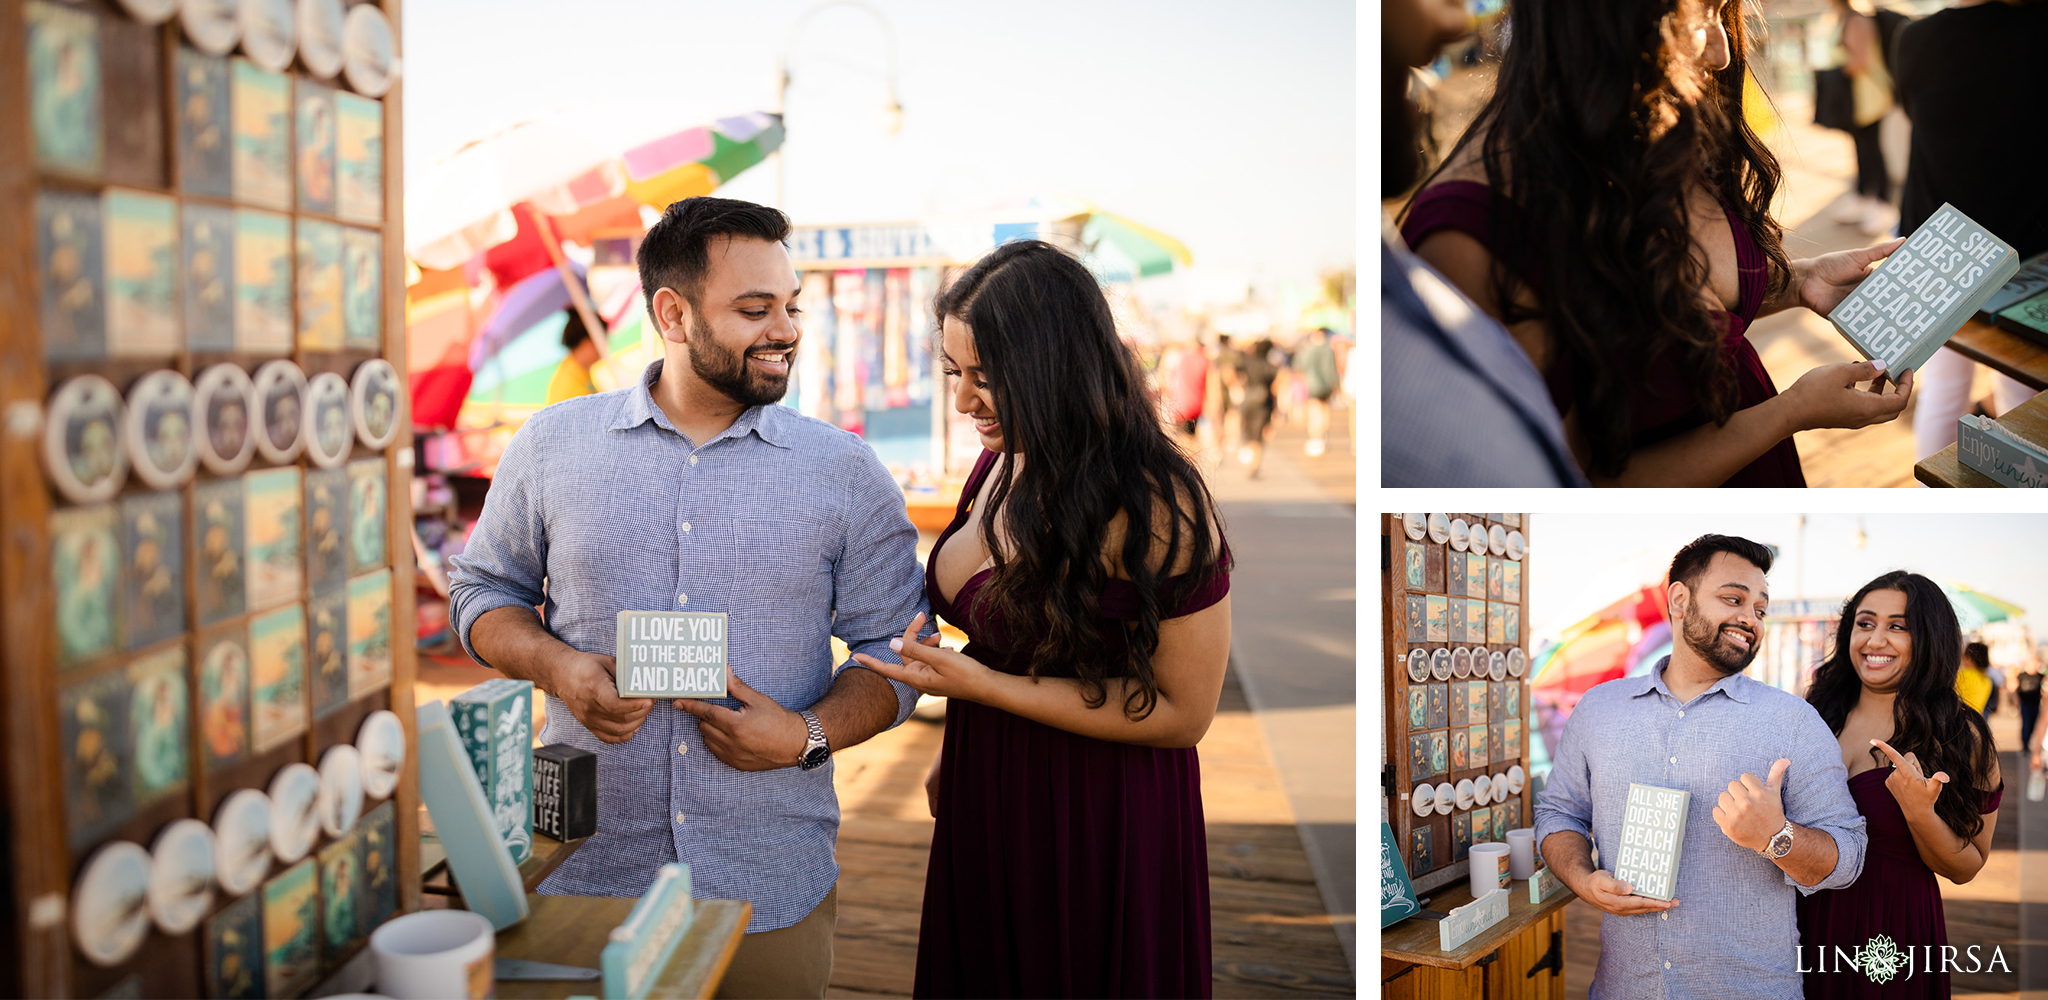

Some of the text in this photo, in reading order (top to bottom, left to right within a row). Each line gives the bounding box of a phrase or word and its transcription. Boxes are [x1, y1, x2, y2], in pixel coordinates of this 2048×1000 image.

[1929, 210, 2005, 268] ALL SHE
[1908, 228, 1964, 274] DOES
[1952, 261, 1984, 289] IS
[1885, 249, 1962, 315] BEACH
[1861, 272, 1937, 340] BEACH
[1836, 296, 1912, 366] BEACH
[1961, 424, 2048, 488] Enjoy unwi
[630, 616, 722, 642] I LOVE YOU
[630, 644, 722, 664] TO THE BEACH
[629, 666, 721, 692] AND BACK
[533, 757, 560, 778] HAPPY
[532, 771, 560, 798] WIFE
[1630, 787, 1680, 811] ALL SHE
[532, 804, 560, 836] LIFE
[1627, 805, 1678, 830] DOES IS
[1624, 824, 1674, 852] BEACH
[1620, 846, 1671, 875] BEACH
[1618, 867, 1668, 897] BEACH
